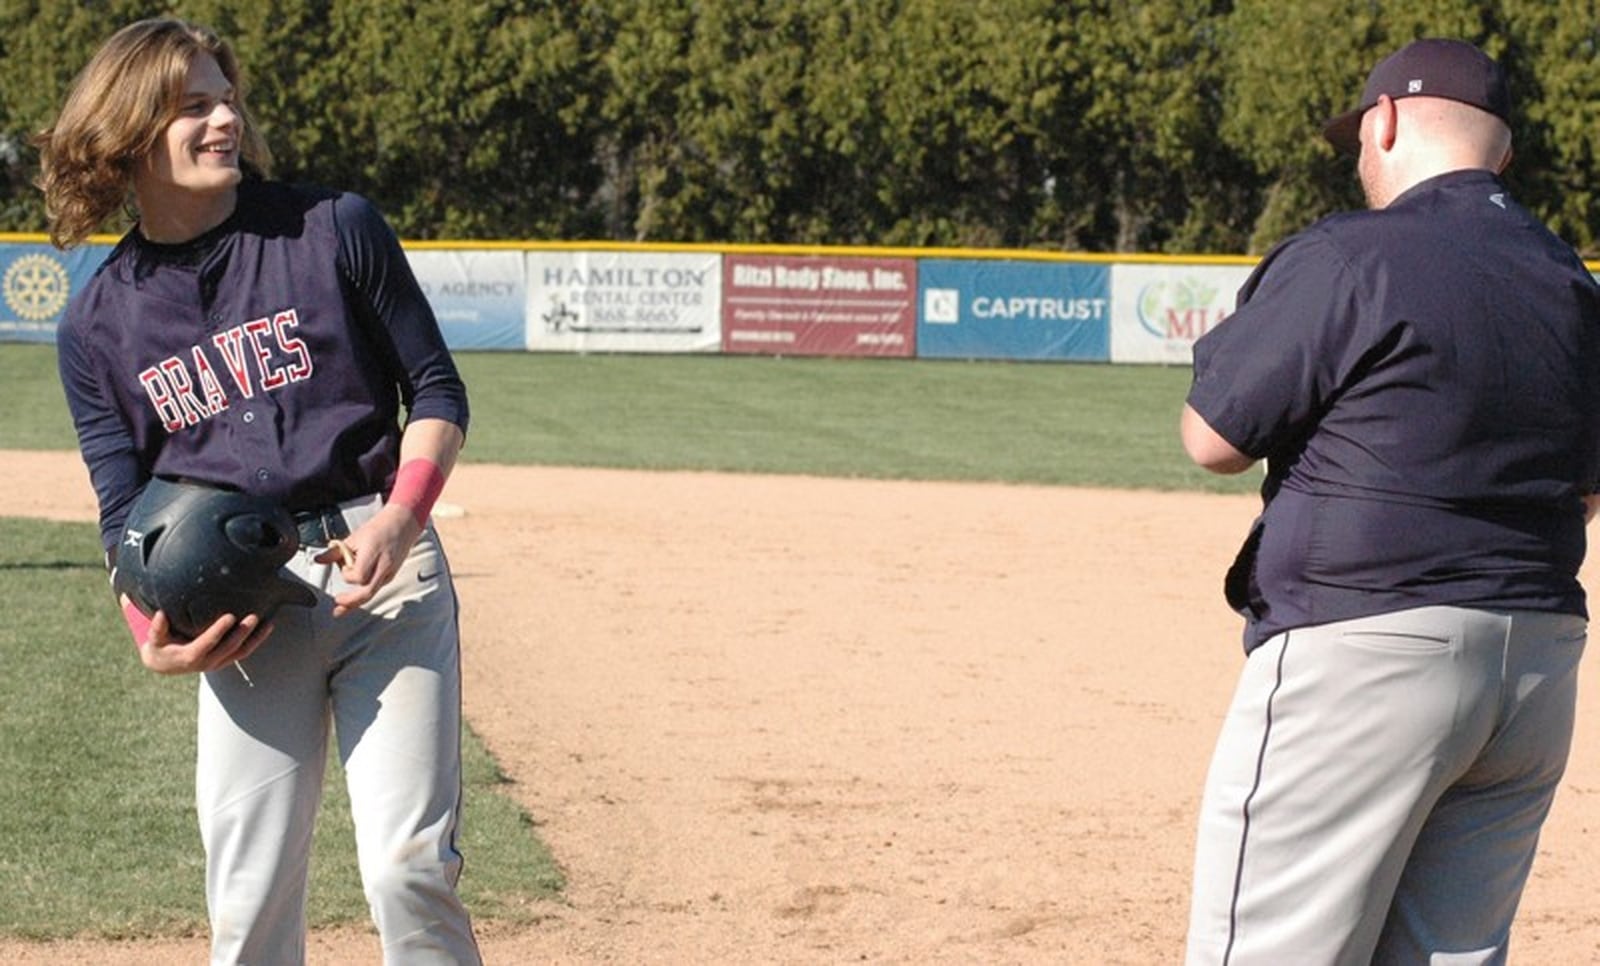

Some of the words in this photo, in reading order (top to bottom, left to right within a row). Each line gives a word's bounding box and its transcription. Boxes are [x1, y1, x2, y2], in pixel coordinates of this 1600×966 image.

[543, 267, 706, 288] HAMILTON
[774, 265, 820, 291] Body
[873, 267, 907, 291] Inc.
[439, 281, 515, 297] AGENCY
[570, 290, 632, 305] RENTAL
[638, 291, 703, 306] CENTER
[592, 308, 679, 324] 868-8665
[972, 296, 1106, 320] CAPTRUST
[138, 308, 313, 432] BRAVES
